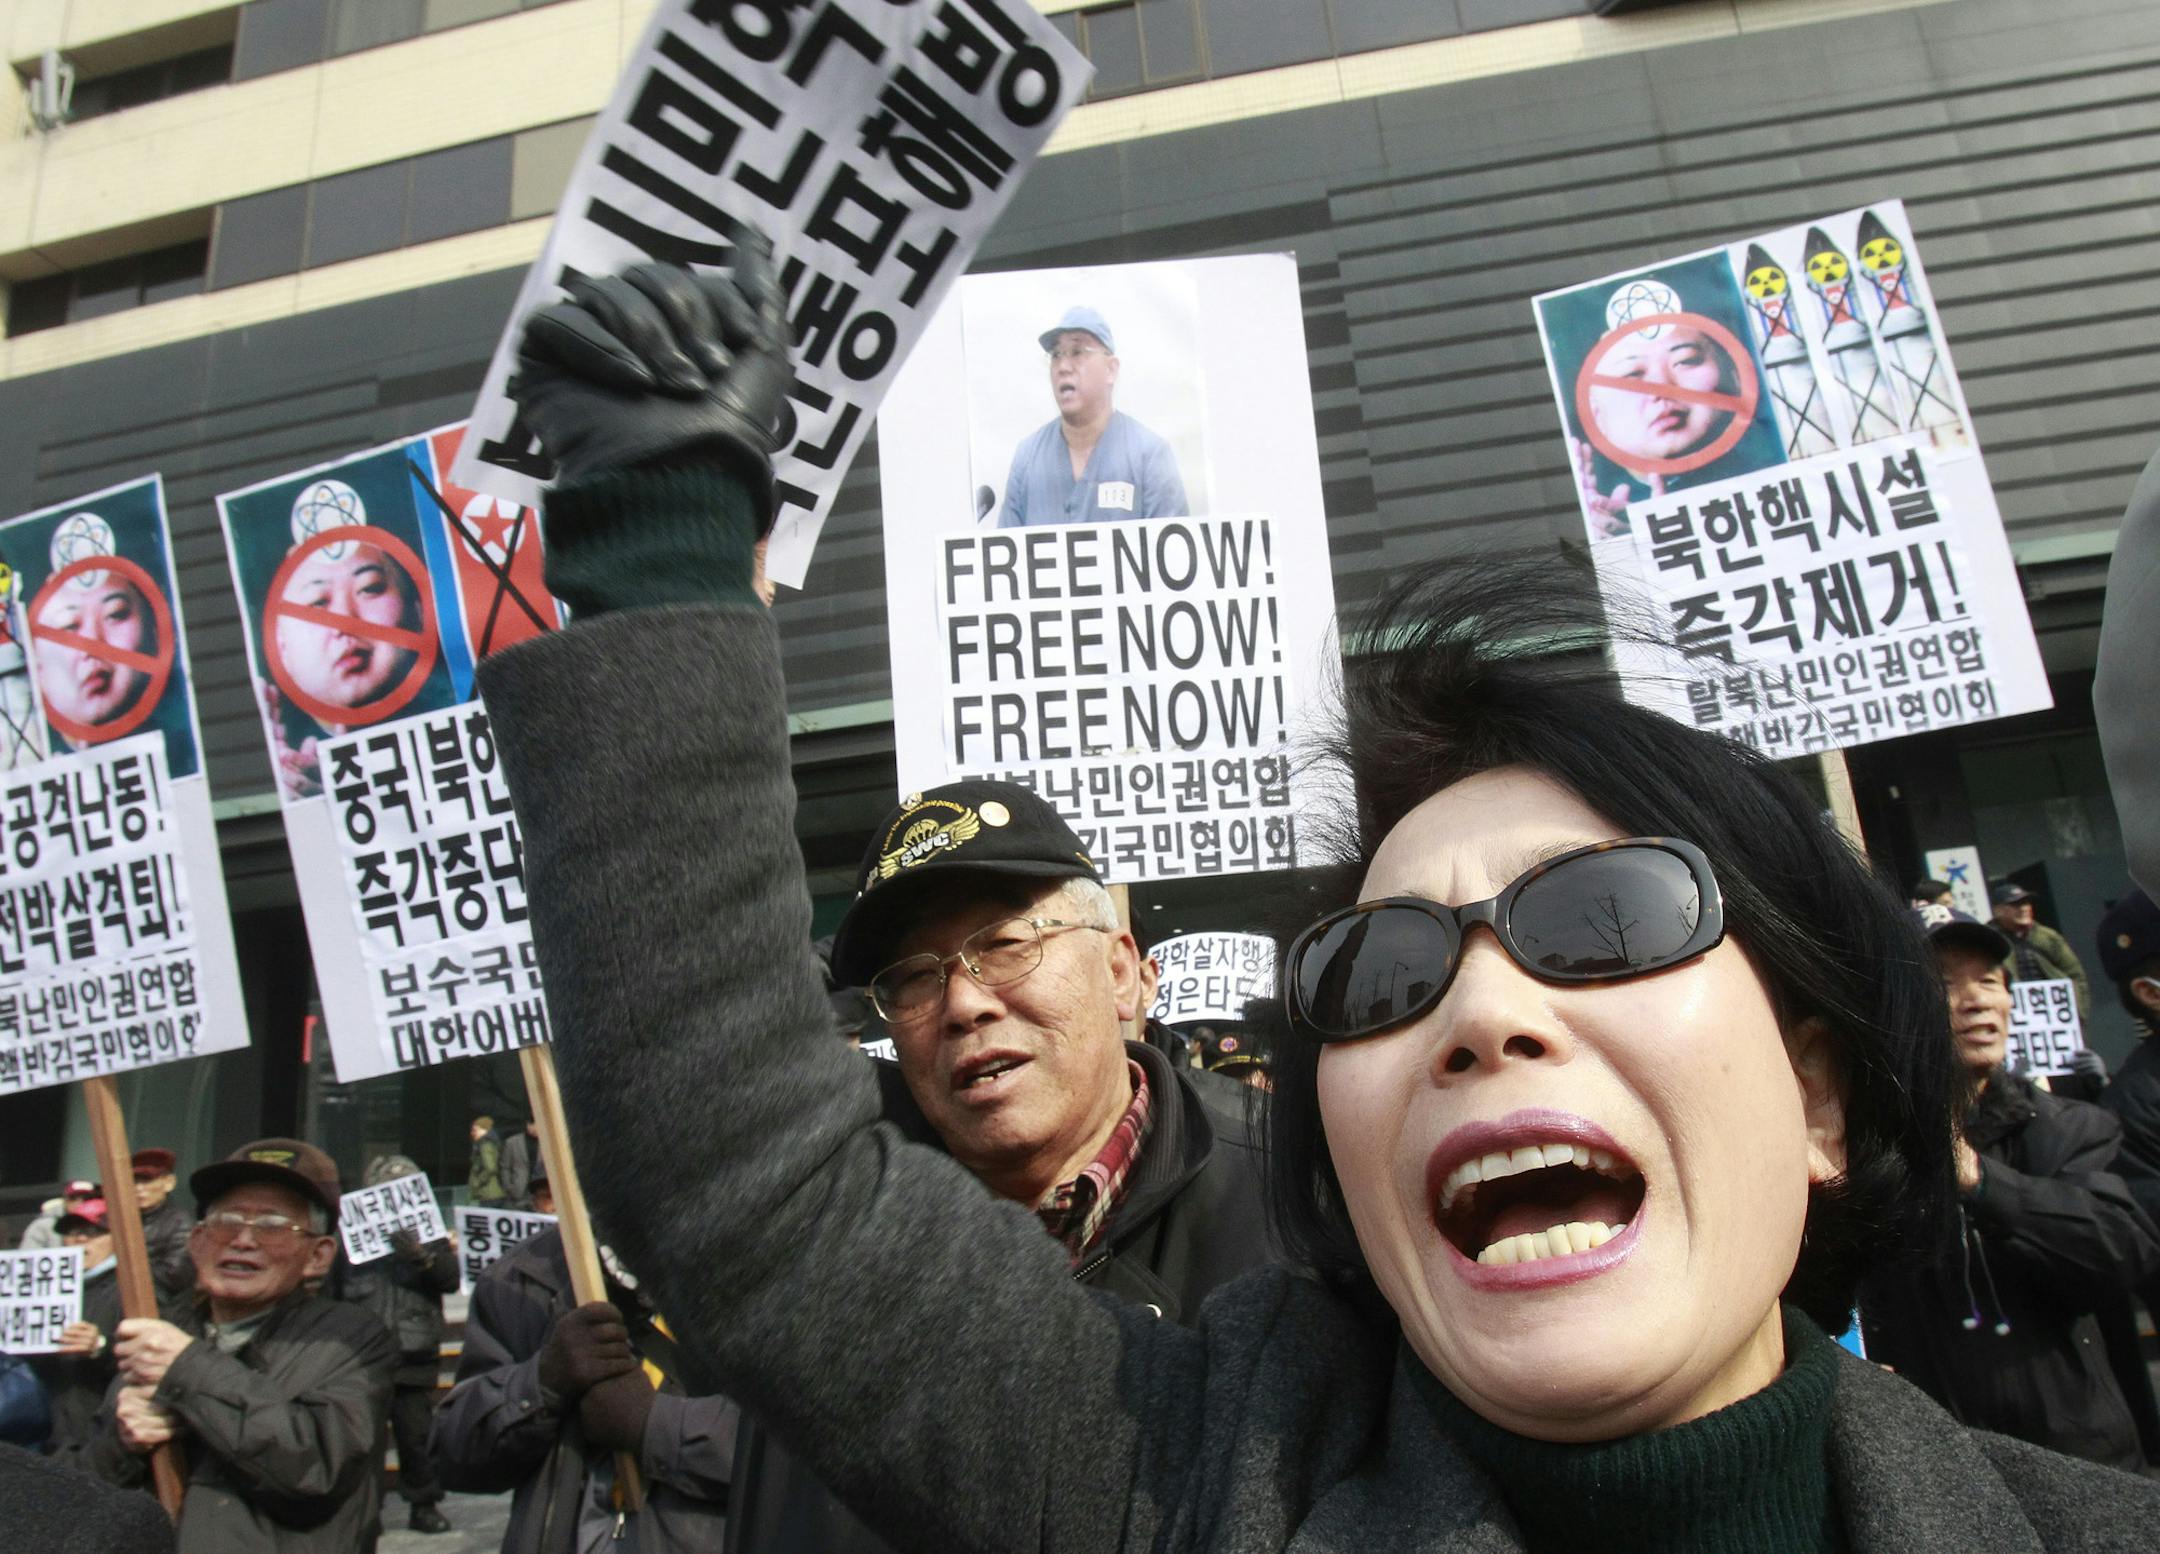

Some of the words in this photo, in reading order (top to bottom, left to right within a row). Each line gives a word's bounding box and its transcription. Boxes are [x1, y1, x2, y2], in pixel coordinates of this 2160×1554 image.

[1646, 448, 1940, 580] 북한핵시설
[944, 529, 1103, 605] FREE
[1112, 519, 1275, 595] NOW!
[1671, 540, 1966, 664] 즉각제거!
[948, 607, 1108, 684] FREE
[1117, 596, 1283, 674] NOW!
[952, 687, 1114, 765] FREE
[1122, 675, 1288, 752] NOW!
[960, 755, 1293, 820] 난민인권연합
[354, 819, 530, 948] 즉각중단
[900, 832, 950, 867] SWC
